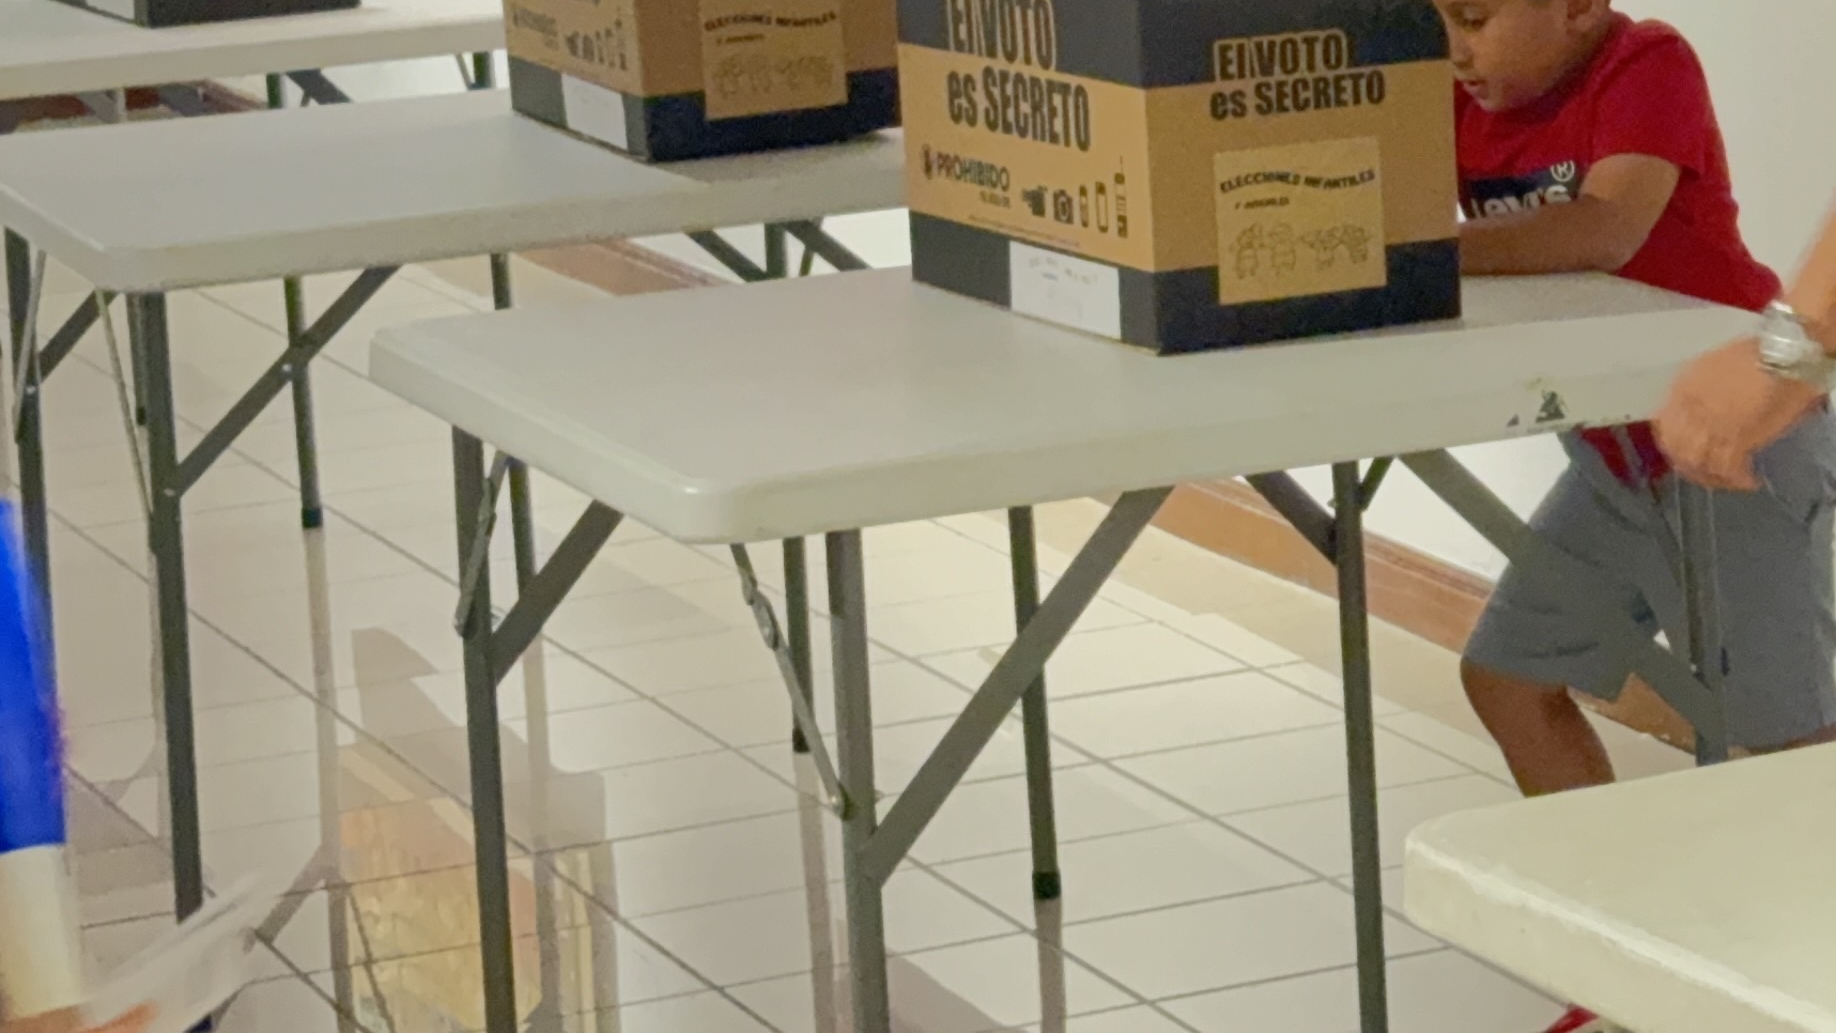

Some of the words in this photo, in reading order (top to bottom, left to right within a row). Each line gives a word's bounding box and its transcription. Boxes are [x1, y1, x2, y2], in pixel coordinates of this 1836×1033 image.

[1254, 33, 1343, 77] VOTO
[947, 70, 978, 127] es
[982, 65, 1091, 152] SECRETO
[1210, 89, 1247, 120] es
[1254, 70, 1386, 115] SECRETO
[936, 152, 1010, 192] PROHIBIDO
[1220, 171, 1300, 193] ELECCIONES
